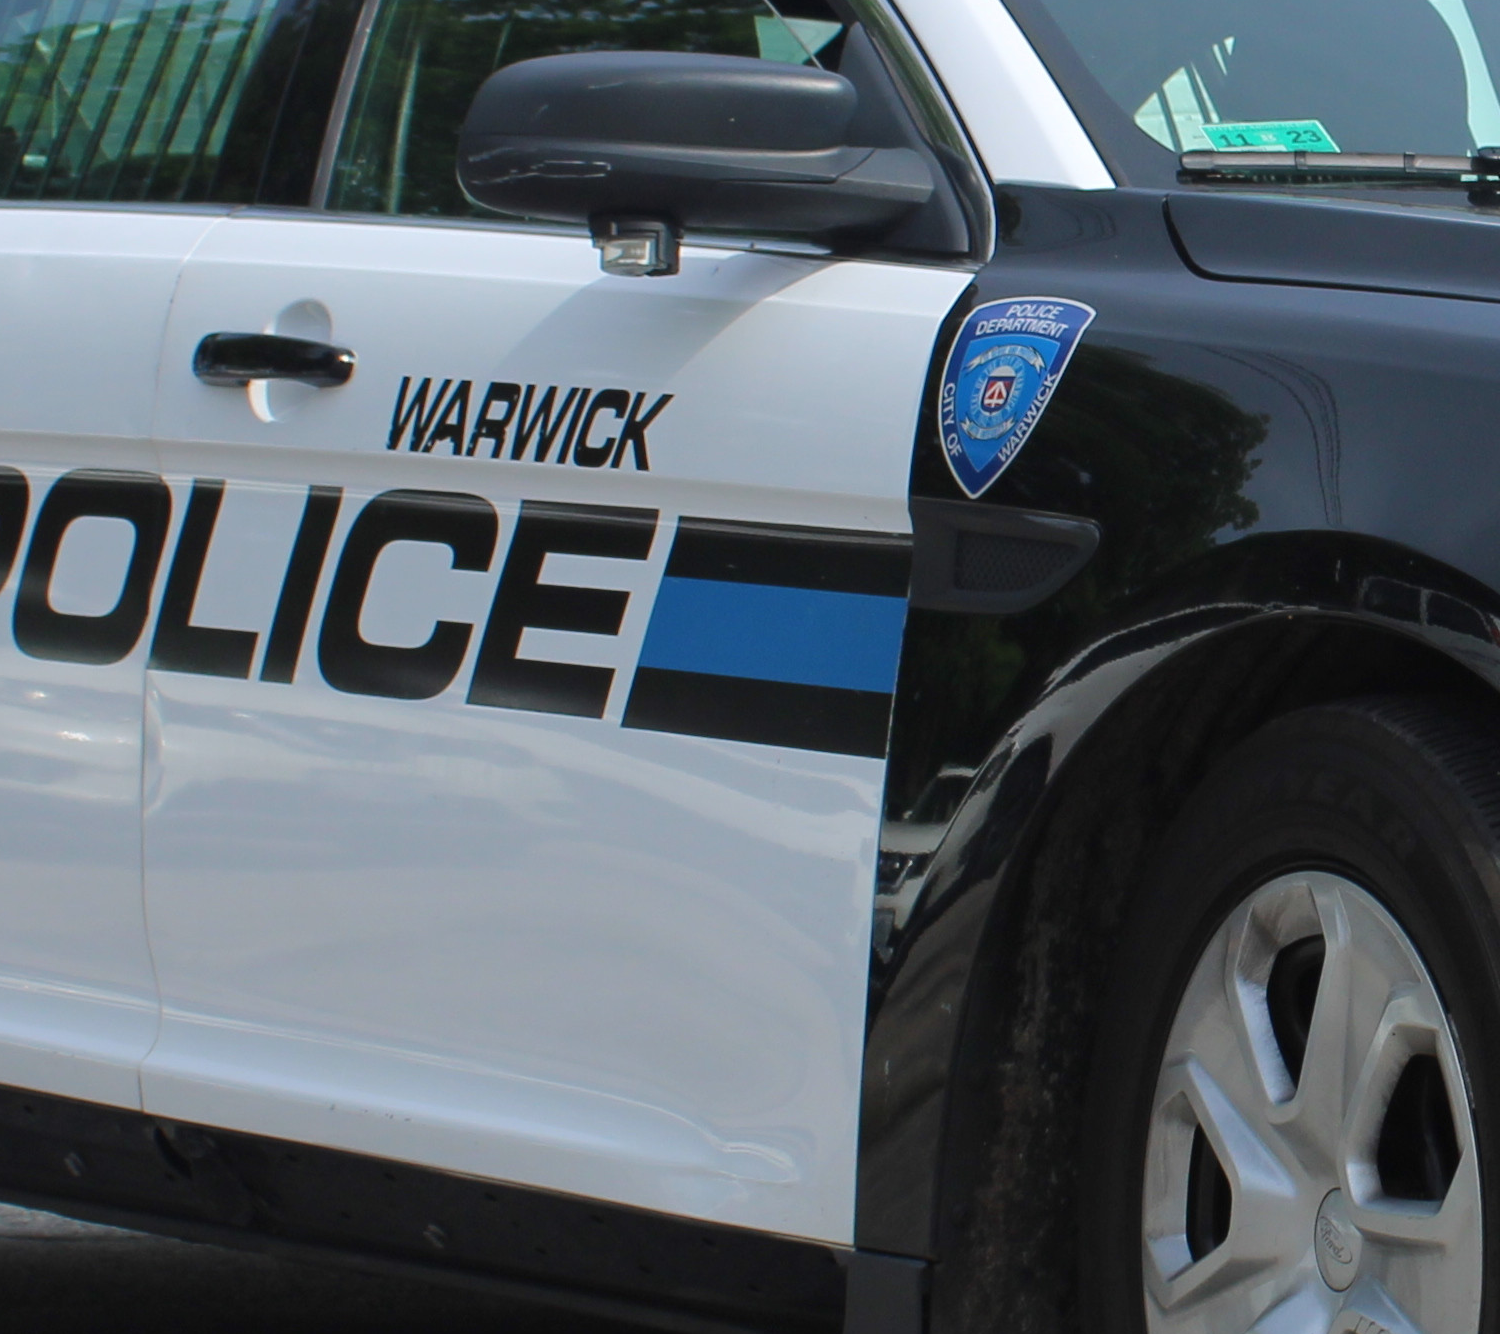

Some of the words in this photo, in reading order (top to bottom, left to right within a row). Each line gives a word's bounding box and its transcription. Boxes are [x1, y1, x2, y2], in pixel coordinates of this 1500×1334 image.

[1219, 133, 1253, 147] 11
[1286, 130, 1322, 144] 23
[1006, 303, 1065, 320] POLICE
[975, 317, 1069, 339] DEPARTMENT
[943, 382, 956, 426] CITY
[386, 375, 675, 472] WARWICK
[997, 373, 1060, 463] WARWICK
[946, 433, 962, 458] OF
